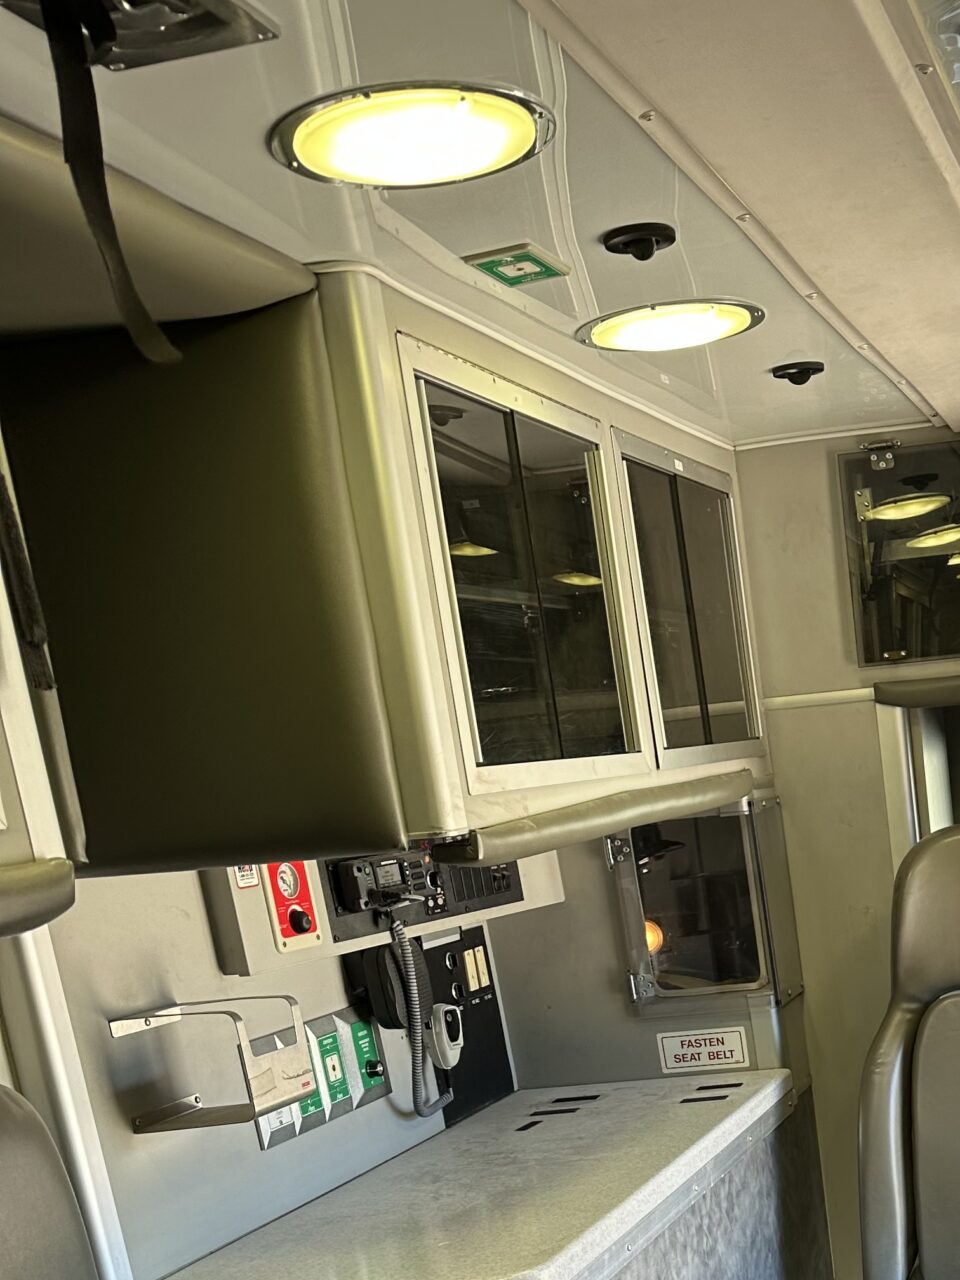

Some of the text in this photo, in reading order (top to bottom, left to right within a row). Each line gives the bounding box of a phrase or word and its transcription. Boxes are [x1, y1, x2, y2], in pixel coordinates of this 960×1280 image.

[680, 1036, 725, 1049] FASTEN
[673, 1049, 735, 1063] SEAT BELT
